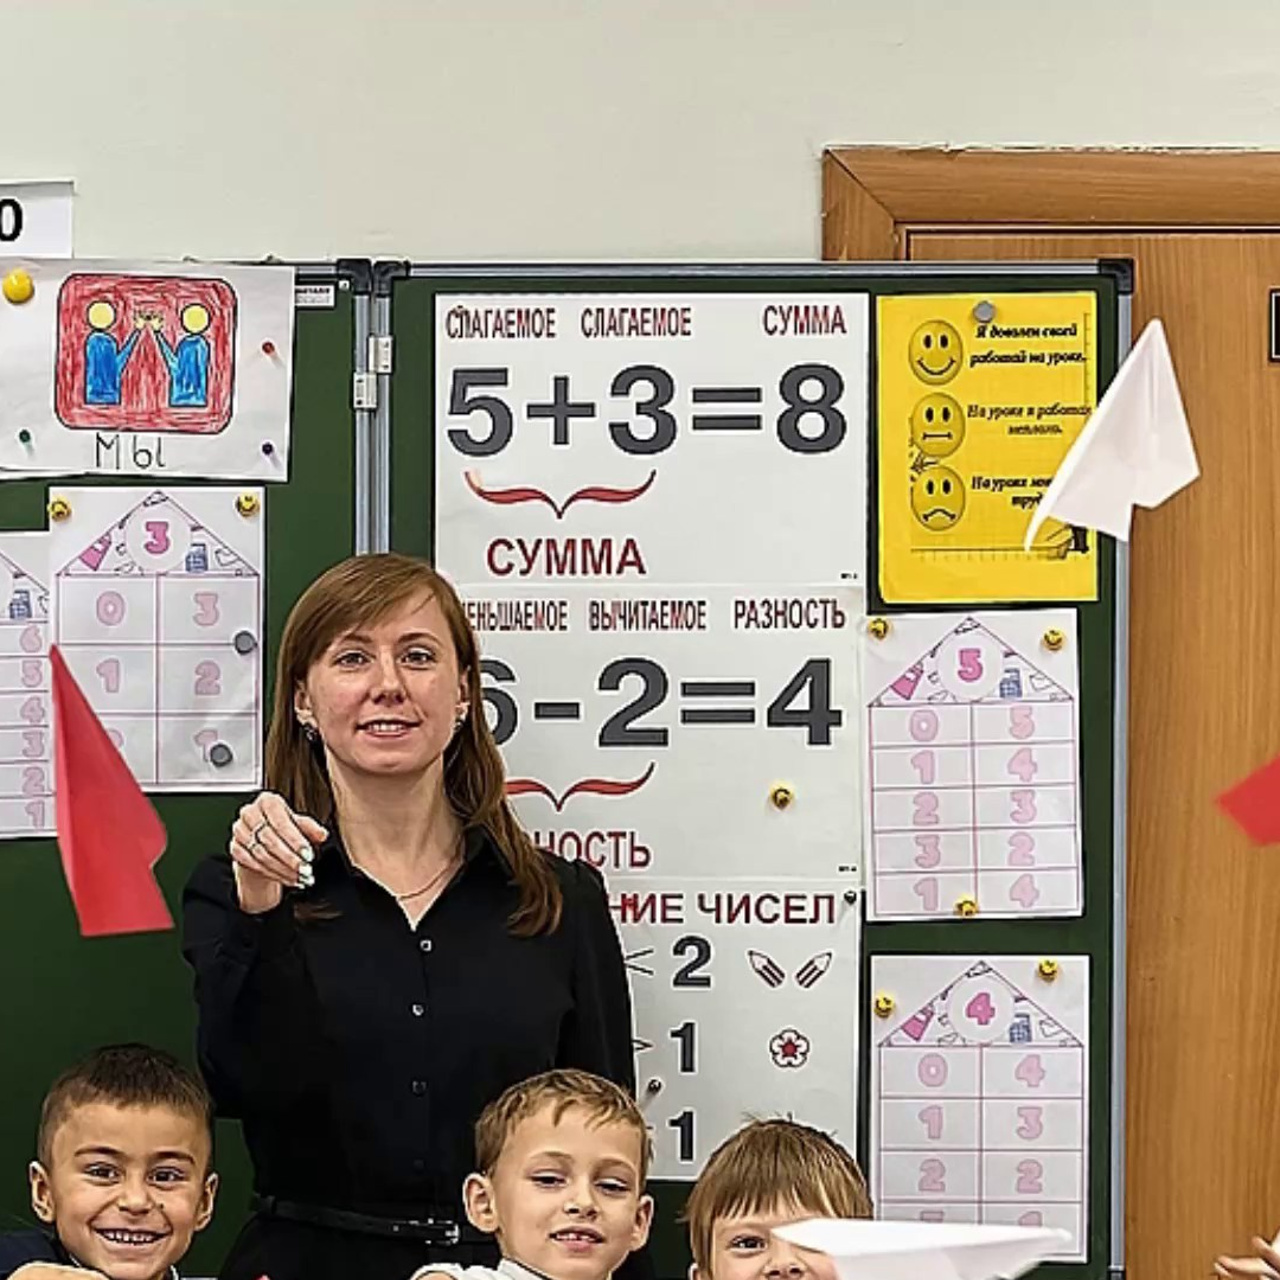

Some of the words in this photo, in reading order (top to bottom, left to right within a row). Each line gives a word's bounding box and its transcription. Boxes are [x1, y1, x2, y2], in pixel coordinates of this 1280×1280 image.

[446, 306, 556, 339] СЛАГАЕМОЕ
[580, 307, 692, 339] СЛАГАЕМОЕ
[763, 305, 848, 336] СУММА
[145, 521, 170, 554] 3
[487, 538, 647, 577] СУММА
[96, 590, 126, 626] 0
[193, 592, 220, 626] 3
[462, 600, 568, 632] ЕНЬШАЕМОЕ
[588, 600, 707, 632] ВЫЧИТАЕМОЕ
[734, 598, 846, 630] РАЗНОСТЬ
[20, 626, 42, 653] 6
[22, 660, 42, 688] 5
[96, 658, 120, 693] 1
[195, 660, 221, 695] 2
[957, 648, 983, 682] 5
[20, 697, 45, 724] 4
[909, 709, 938, 742] 0
[1009, 705, 1035, 739] 5
[22, 766, 45, 794] 2
[910, 750, 935, 784] 1
[1007, 748, 1038, 782] 4
[25, 800, 45, 829] 1
[912, 791, 939, 826] 2
[1010, 789, 1037, 824] 3
[533, 830, 651, 869] НОСТЬ
[915, 833, 941, 868] 3
[1008, 832, 1035, 866] 2
[697, 893, 835, 925] ЧИСЕЛ
[914, 877, 938, 911] 1
[1009, 873, 1039, 908] 4
[672, 935, 711, 988] 2
[965, 992, 996, 1025] 4
[670, 1022, 696, 1073] 1
[918, 1053, 948, 1087] 0
[1014, 1053, 1045, 1087] 4
[669, 1110, 694, 1162] 1
[918, 1105, 943, 1139] 1
[1017, 1106, 1043, 1140] 3
[918, 1158, 945, 1192] 2
[1017, 1158, 1043, 1193] 2
